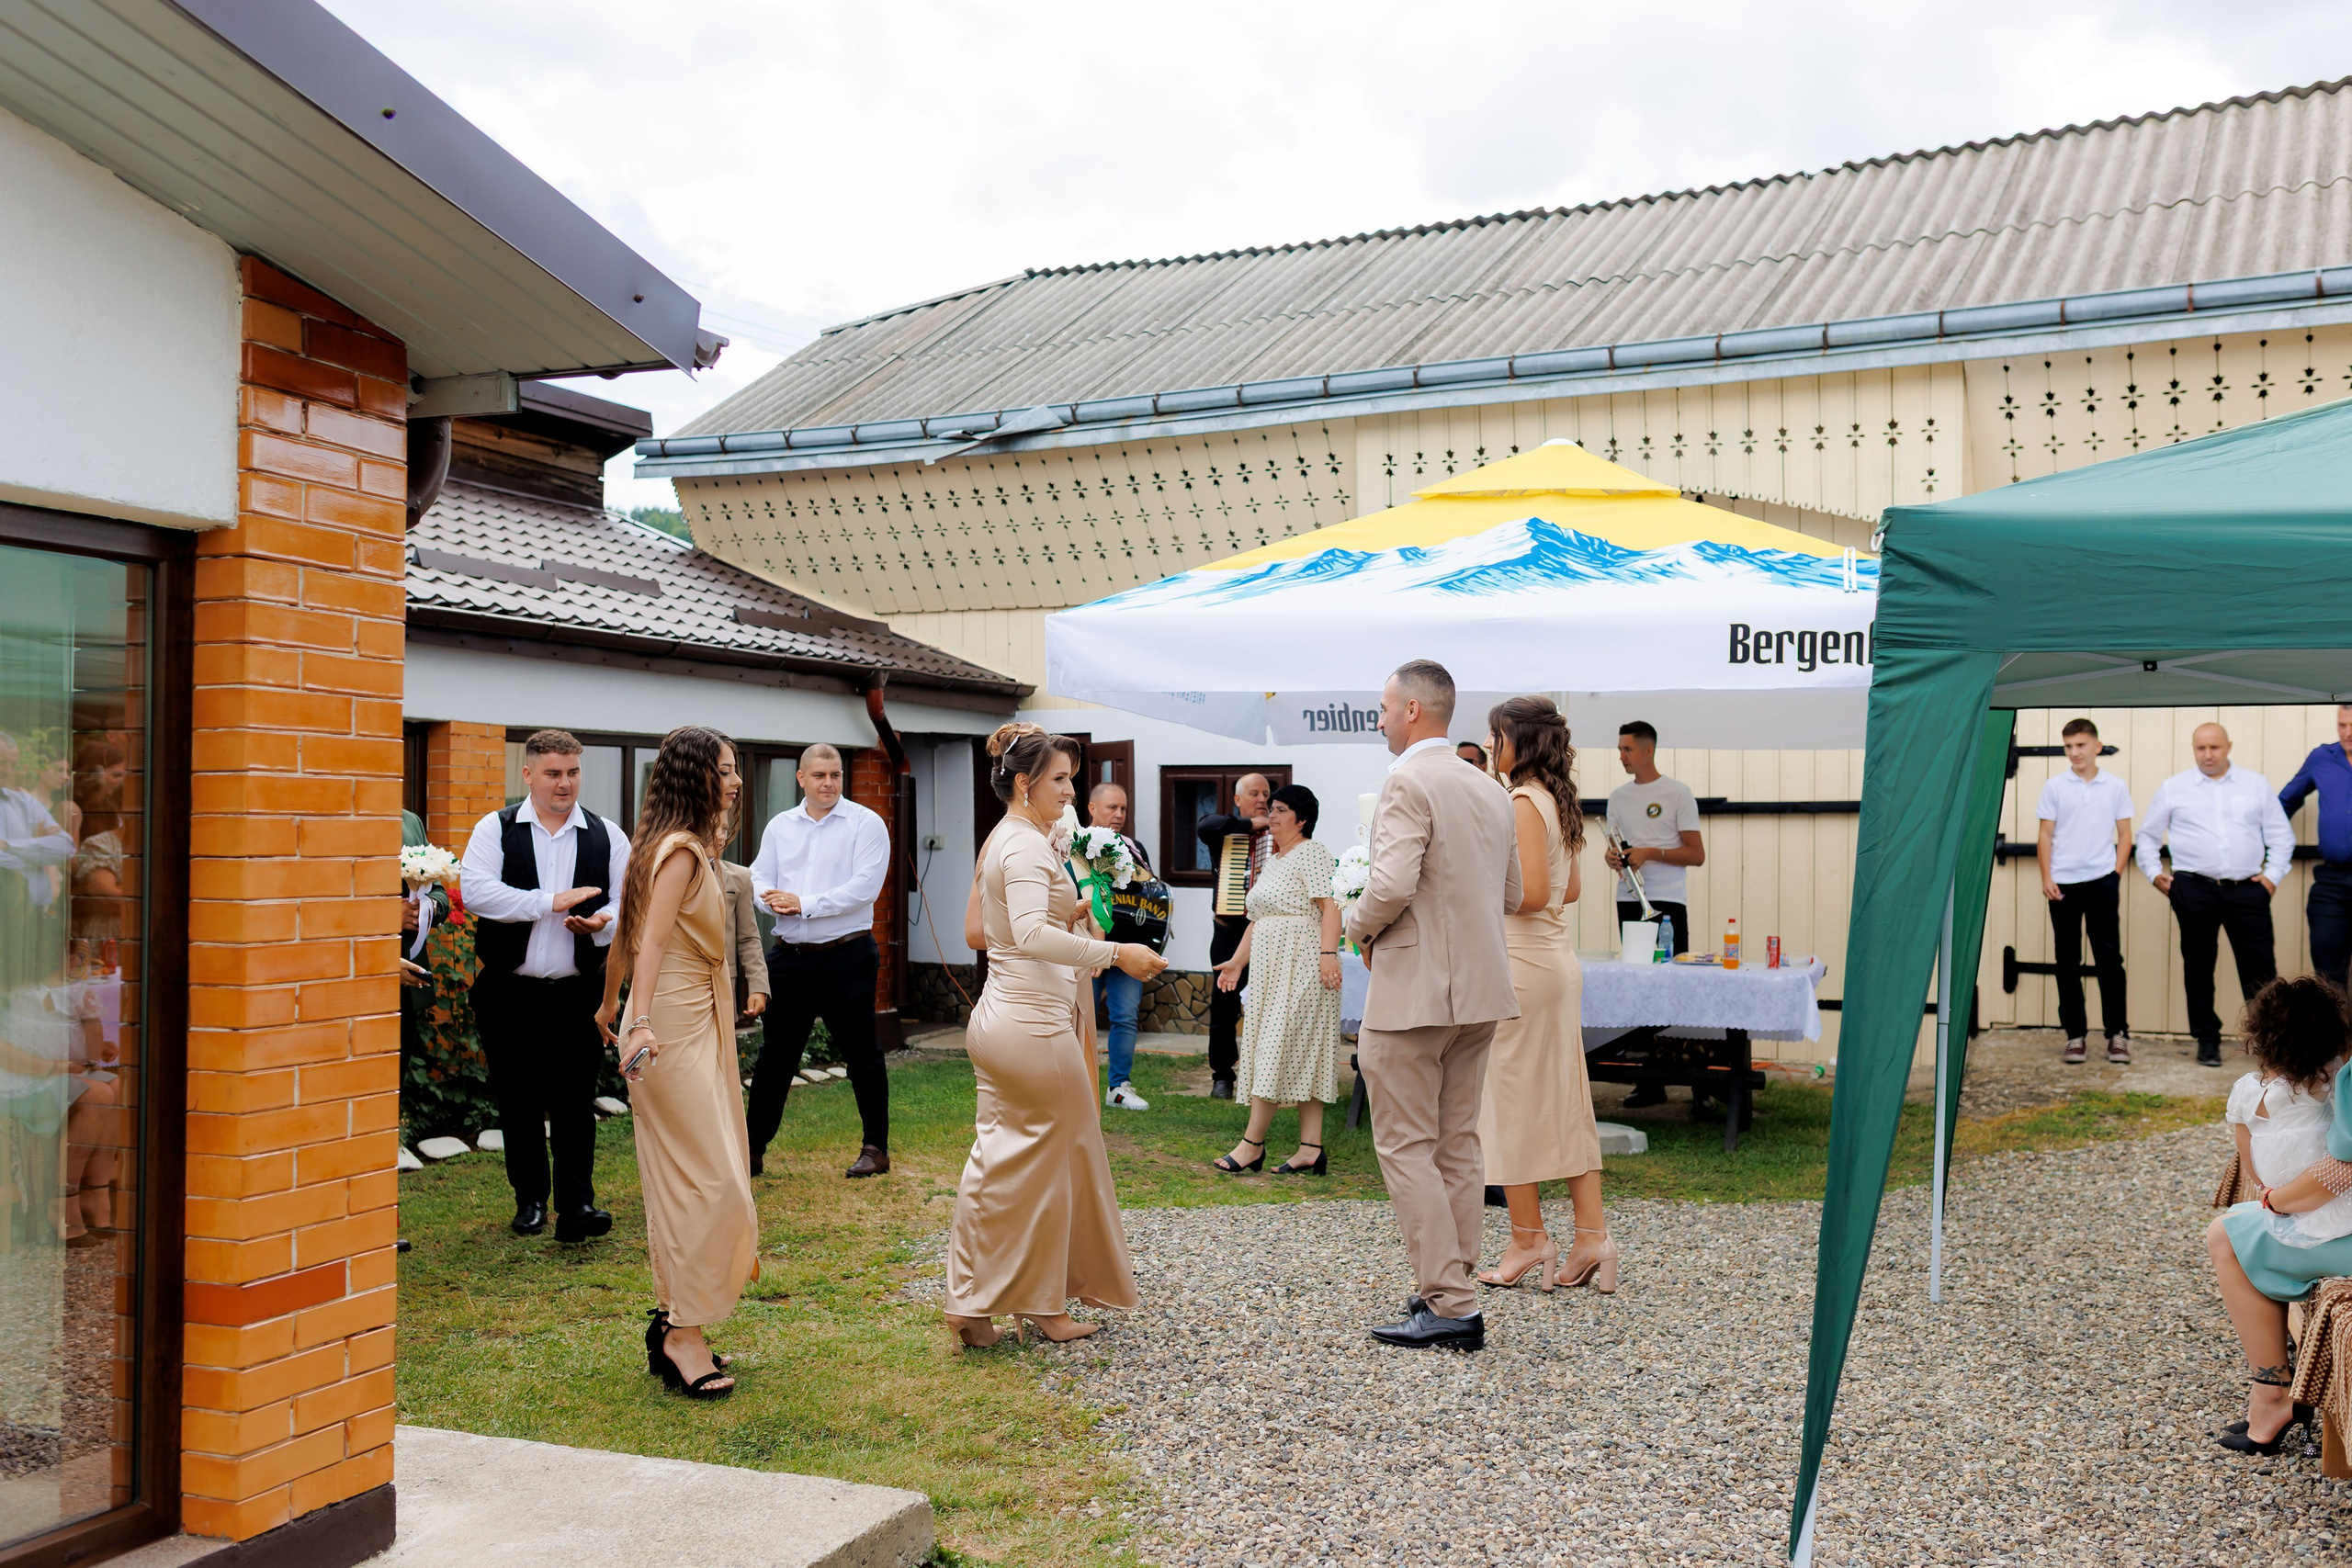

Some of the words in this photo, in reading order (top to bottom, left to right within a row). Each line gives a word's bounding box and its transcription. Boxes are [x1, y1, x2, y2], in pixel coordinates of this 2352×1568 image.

[1728, 621, 1875, 672] Bergen
[1110, 894, 1137, 907] ENIAL
[1140, 897, 1167, 920] BAND
